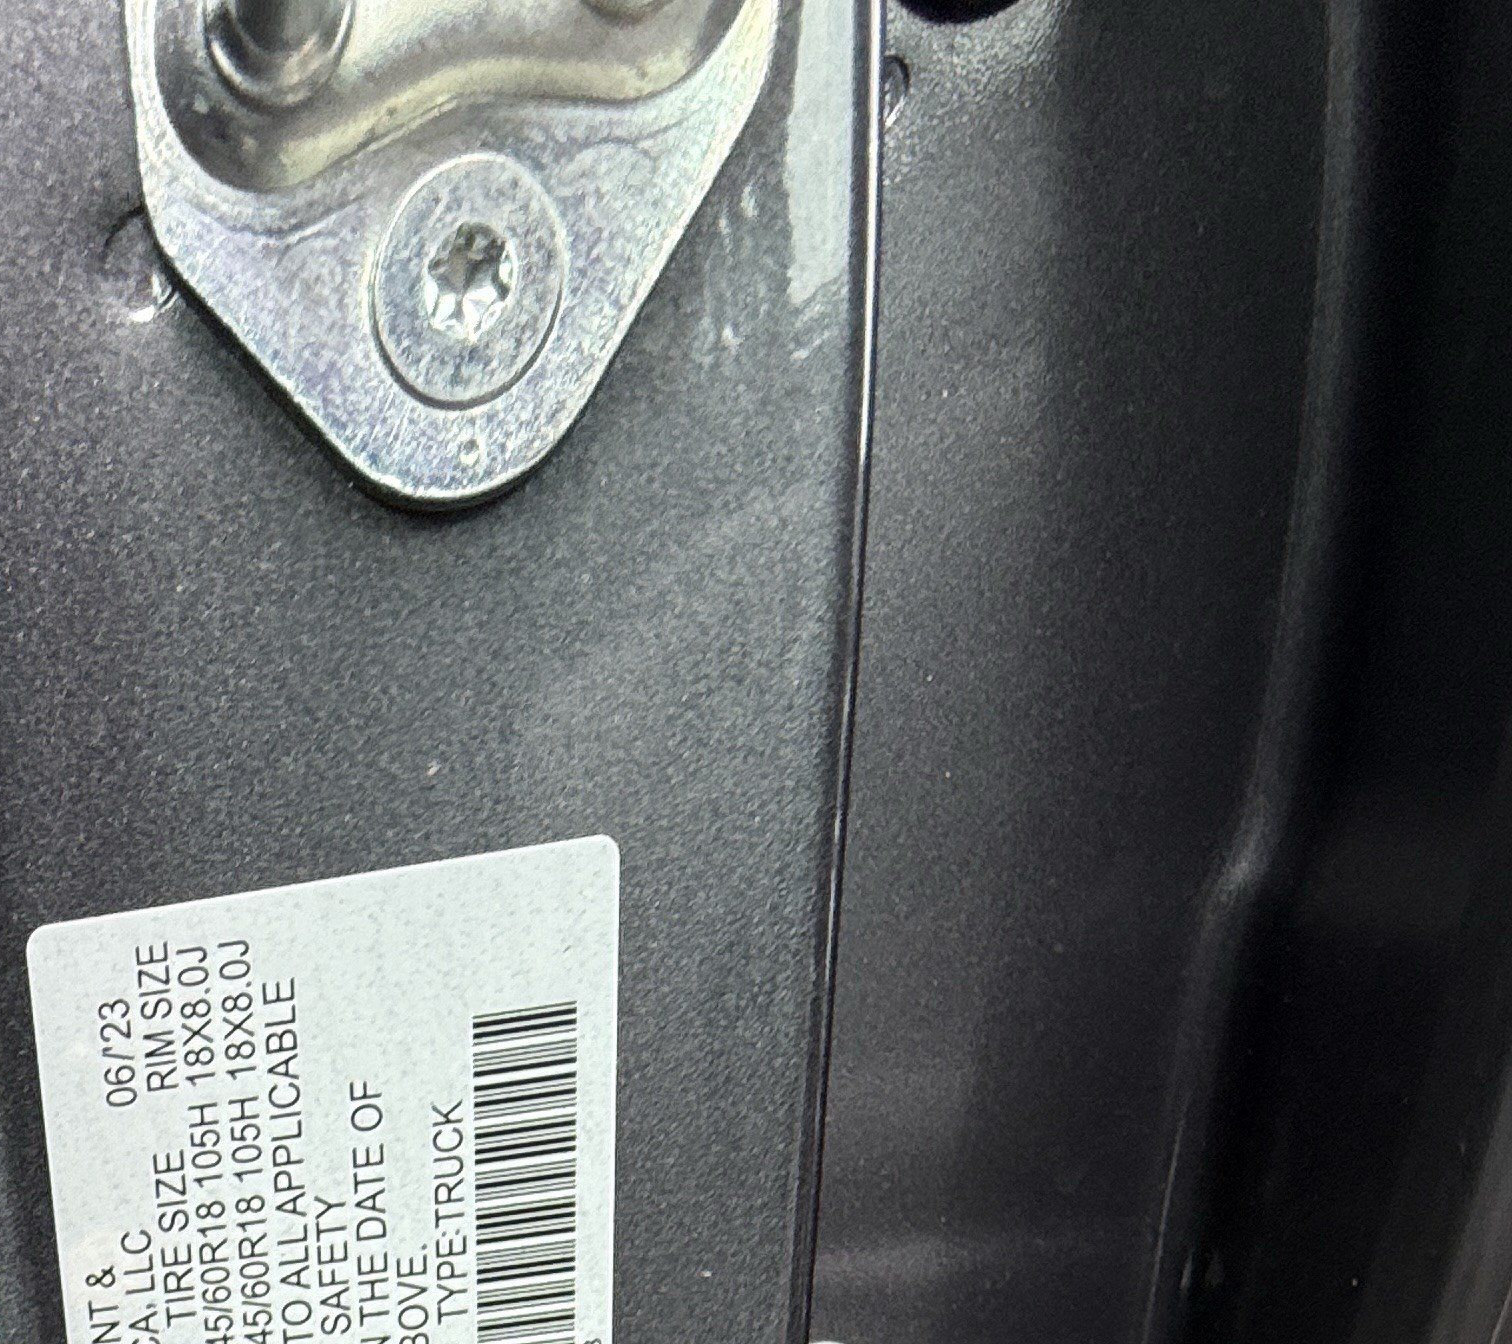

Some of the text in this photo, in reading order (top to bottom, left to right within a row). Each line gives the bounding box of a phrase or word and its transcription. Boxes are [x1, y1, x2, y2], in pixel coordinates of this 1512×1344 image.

[135, 941, 179, 1092] RIM SIZE
[176, 946, 216, 1086] 18X8.0J
[218, 940, 257, 1080] 18X8.0J
[187, 1102, 223, 1188] 105H
[227, 1096, 263, 1183] 105H
[262, 977, 308, 1217] APPLICABLE
[349, 1081, 384, 1132] OF
[152, 1149, 197, 1329] TIRE SIZE
[352, 1142, 387, 1242] DATE
[431, 1099, 468, 1325] TYPE:TRUCK
[86, 1265, 116, 1288] &
[120, 1229, 156, 1295] LLC
[277, 1223, 311, 1290] ALL
[313, 1196, 352, 1335] SAFETY
[356, 1251, 390, 1327] THE
